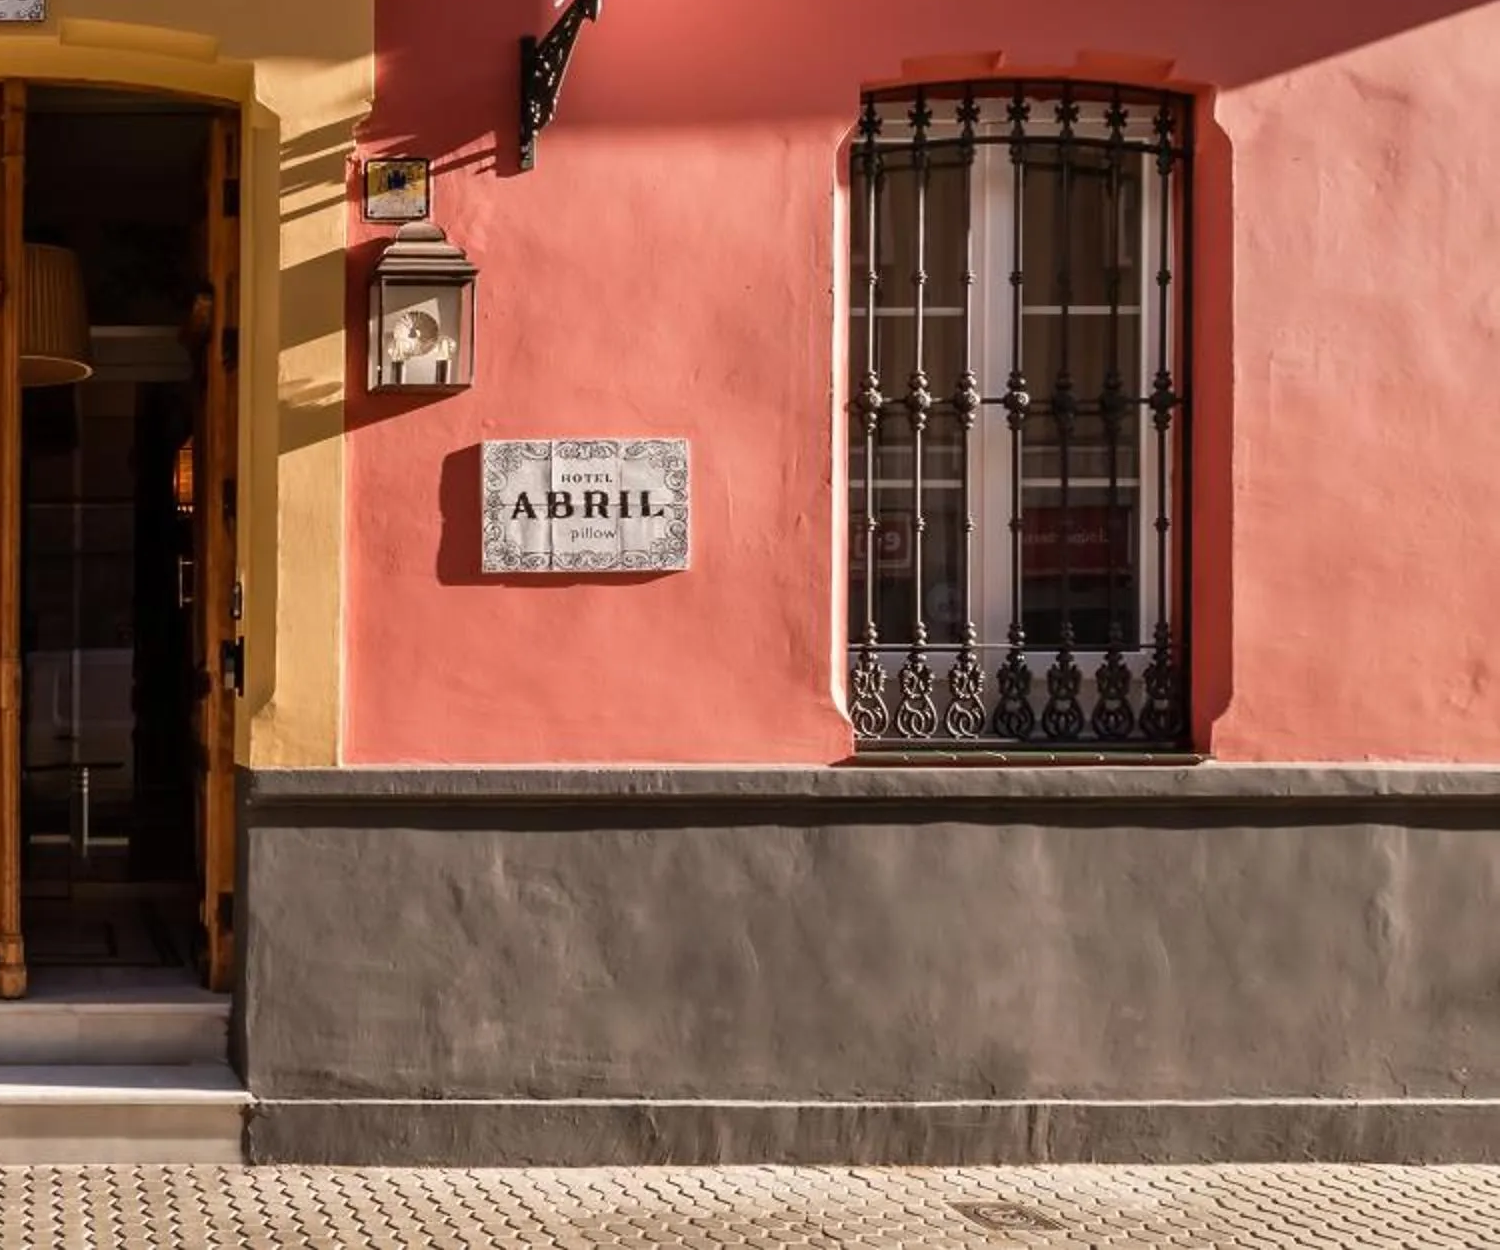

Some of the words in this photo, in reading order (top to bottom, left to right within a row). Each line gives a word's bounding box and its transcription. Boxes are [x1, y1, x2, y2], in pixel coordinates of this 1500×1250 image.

[561, 473, 613, 483] HOTEL
[511, 490, 665, 519] ABRIL
[570, 526, 616, 542] pillow
